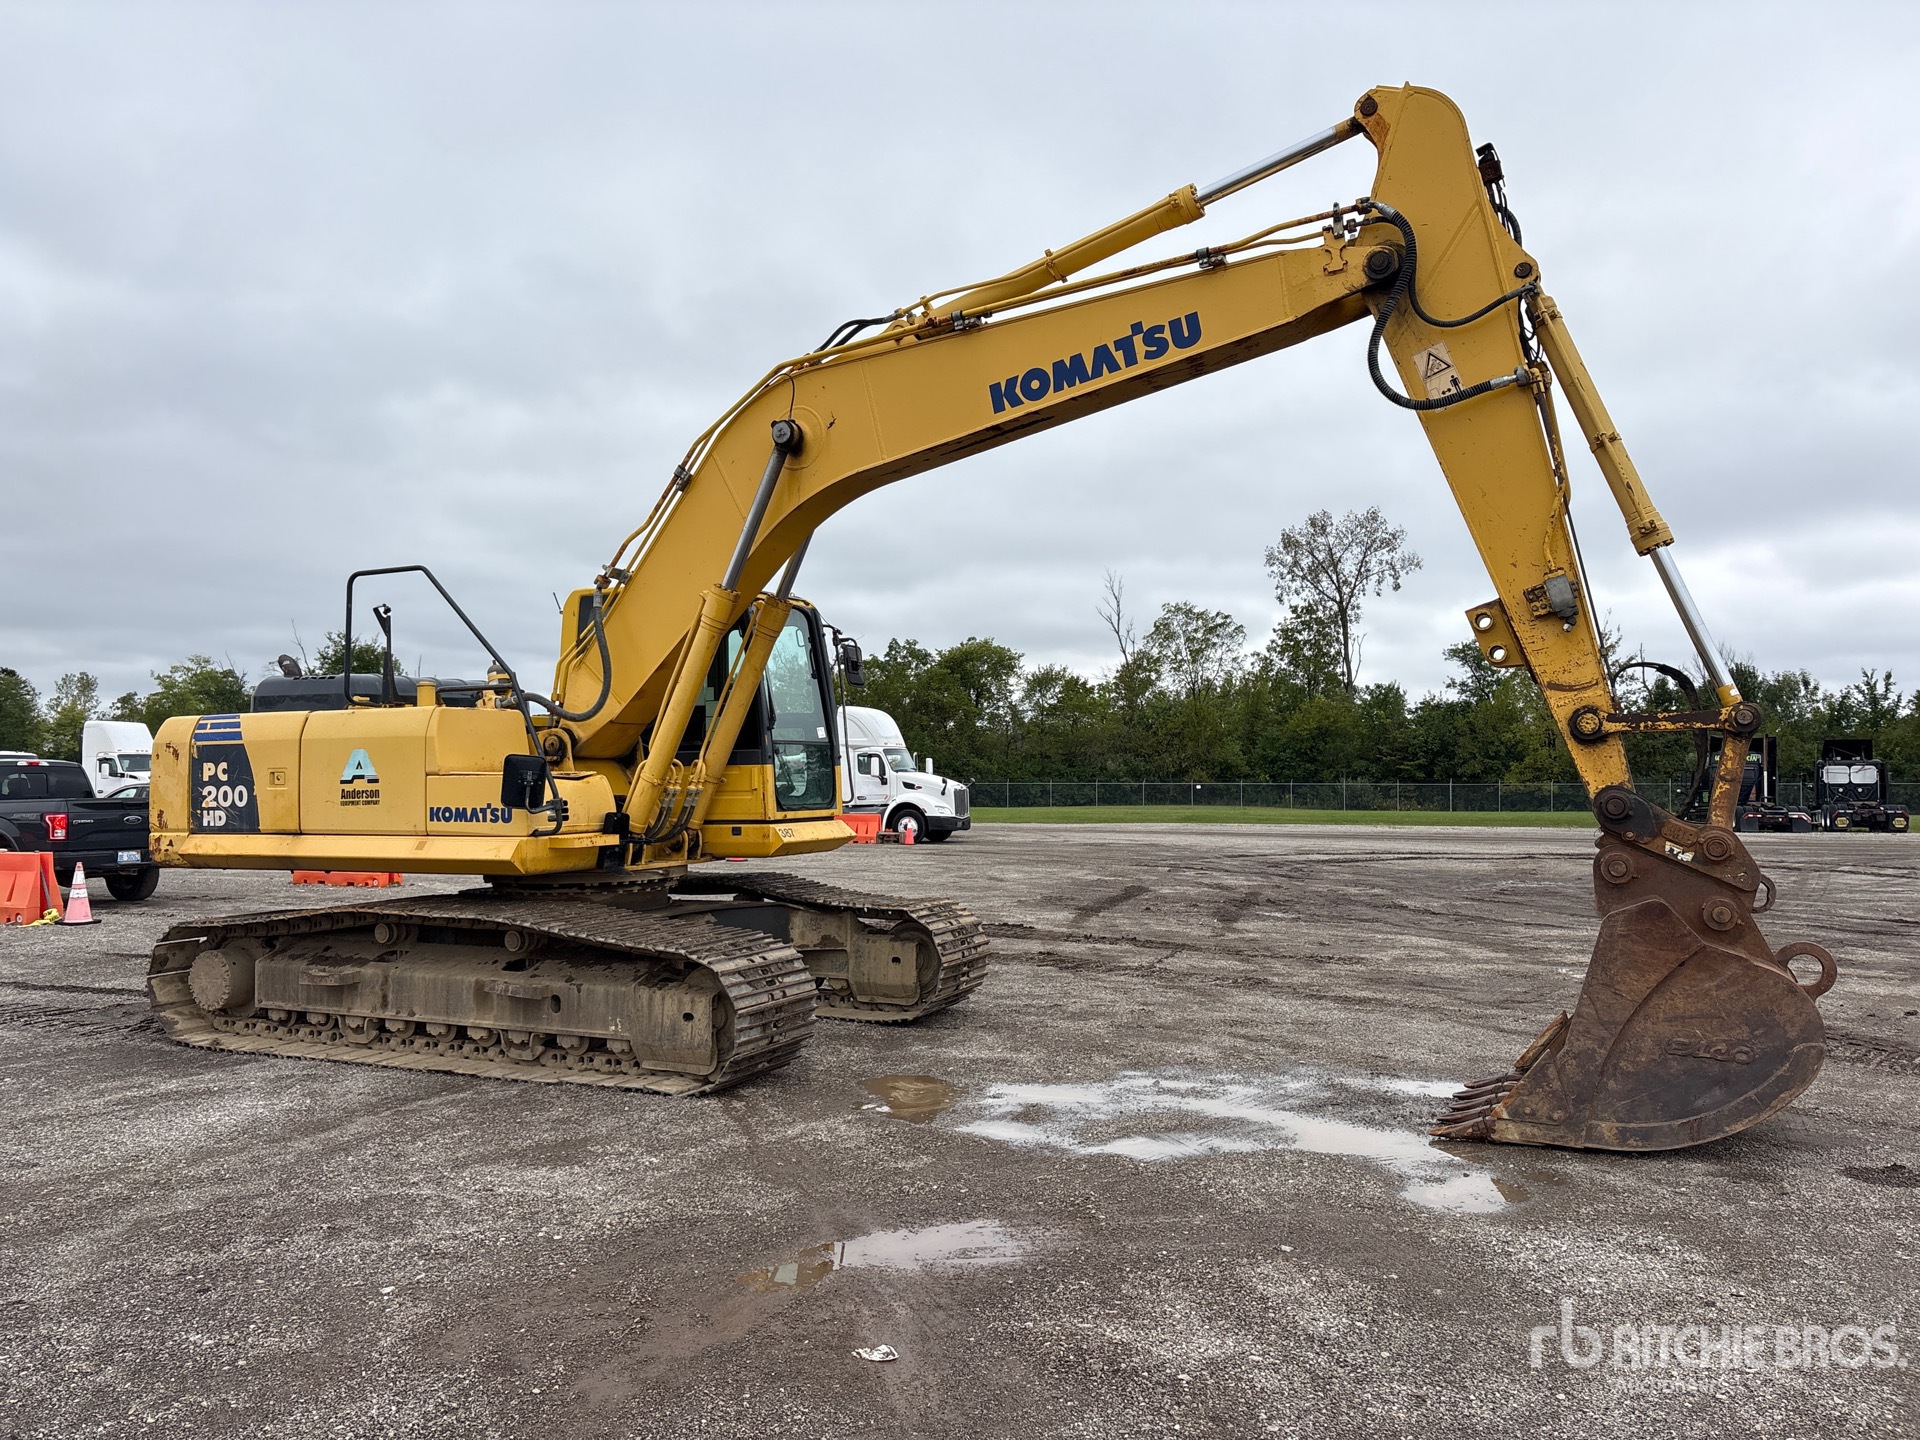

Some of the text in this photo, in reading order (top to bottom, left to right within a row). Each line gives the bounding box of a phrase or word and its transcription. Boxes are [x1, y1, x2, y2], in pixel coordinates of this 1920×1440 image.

[988, 311, 1202, 415] KOMATSU
[202, 762, 228, 781] PC
[201, 785, 248, 808] 200
[340, 788, 380, 800] Anderson
[202, 810, 227, 827] HD
[429, 803, 513, 824] KOMATSU
[778, 828, 795, 838] 387
